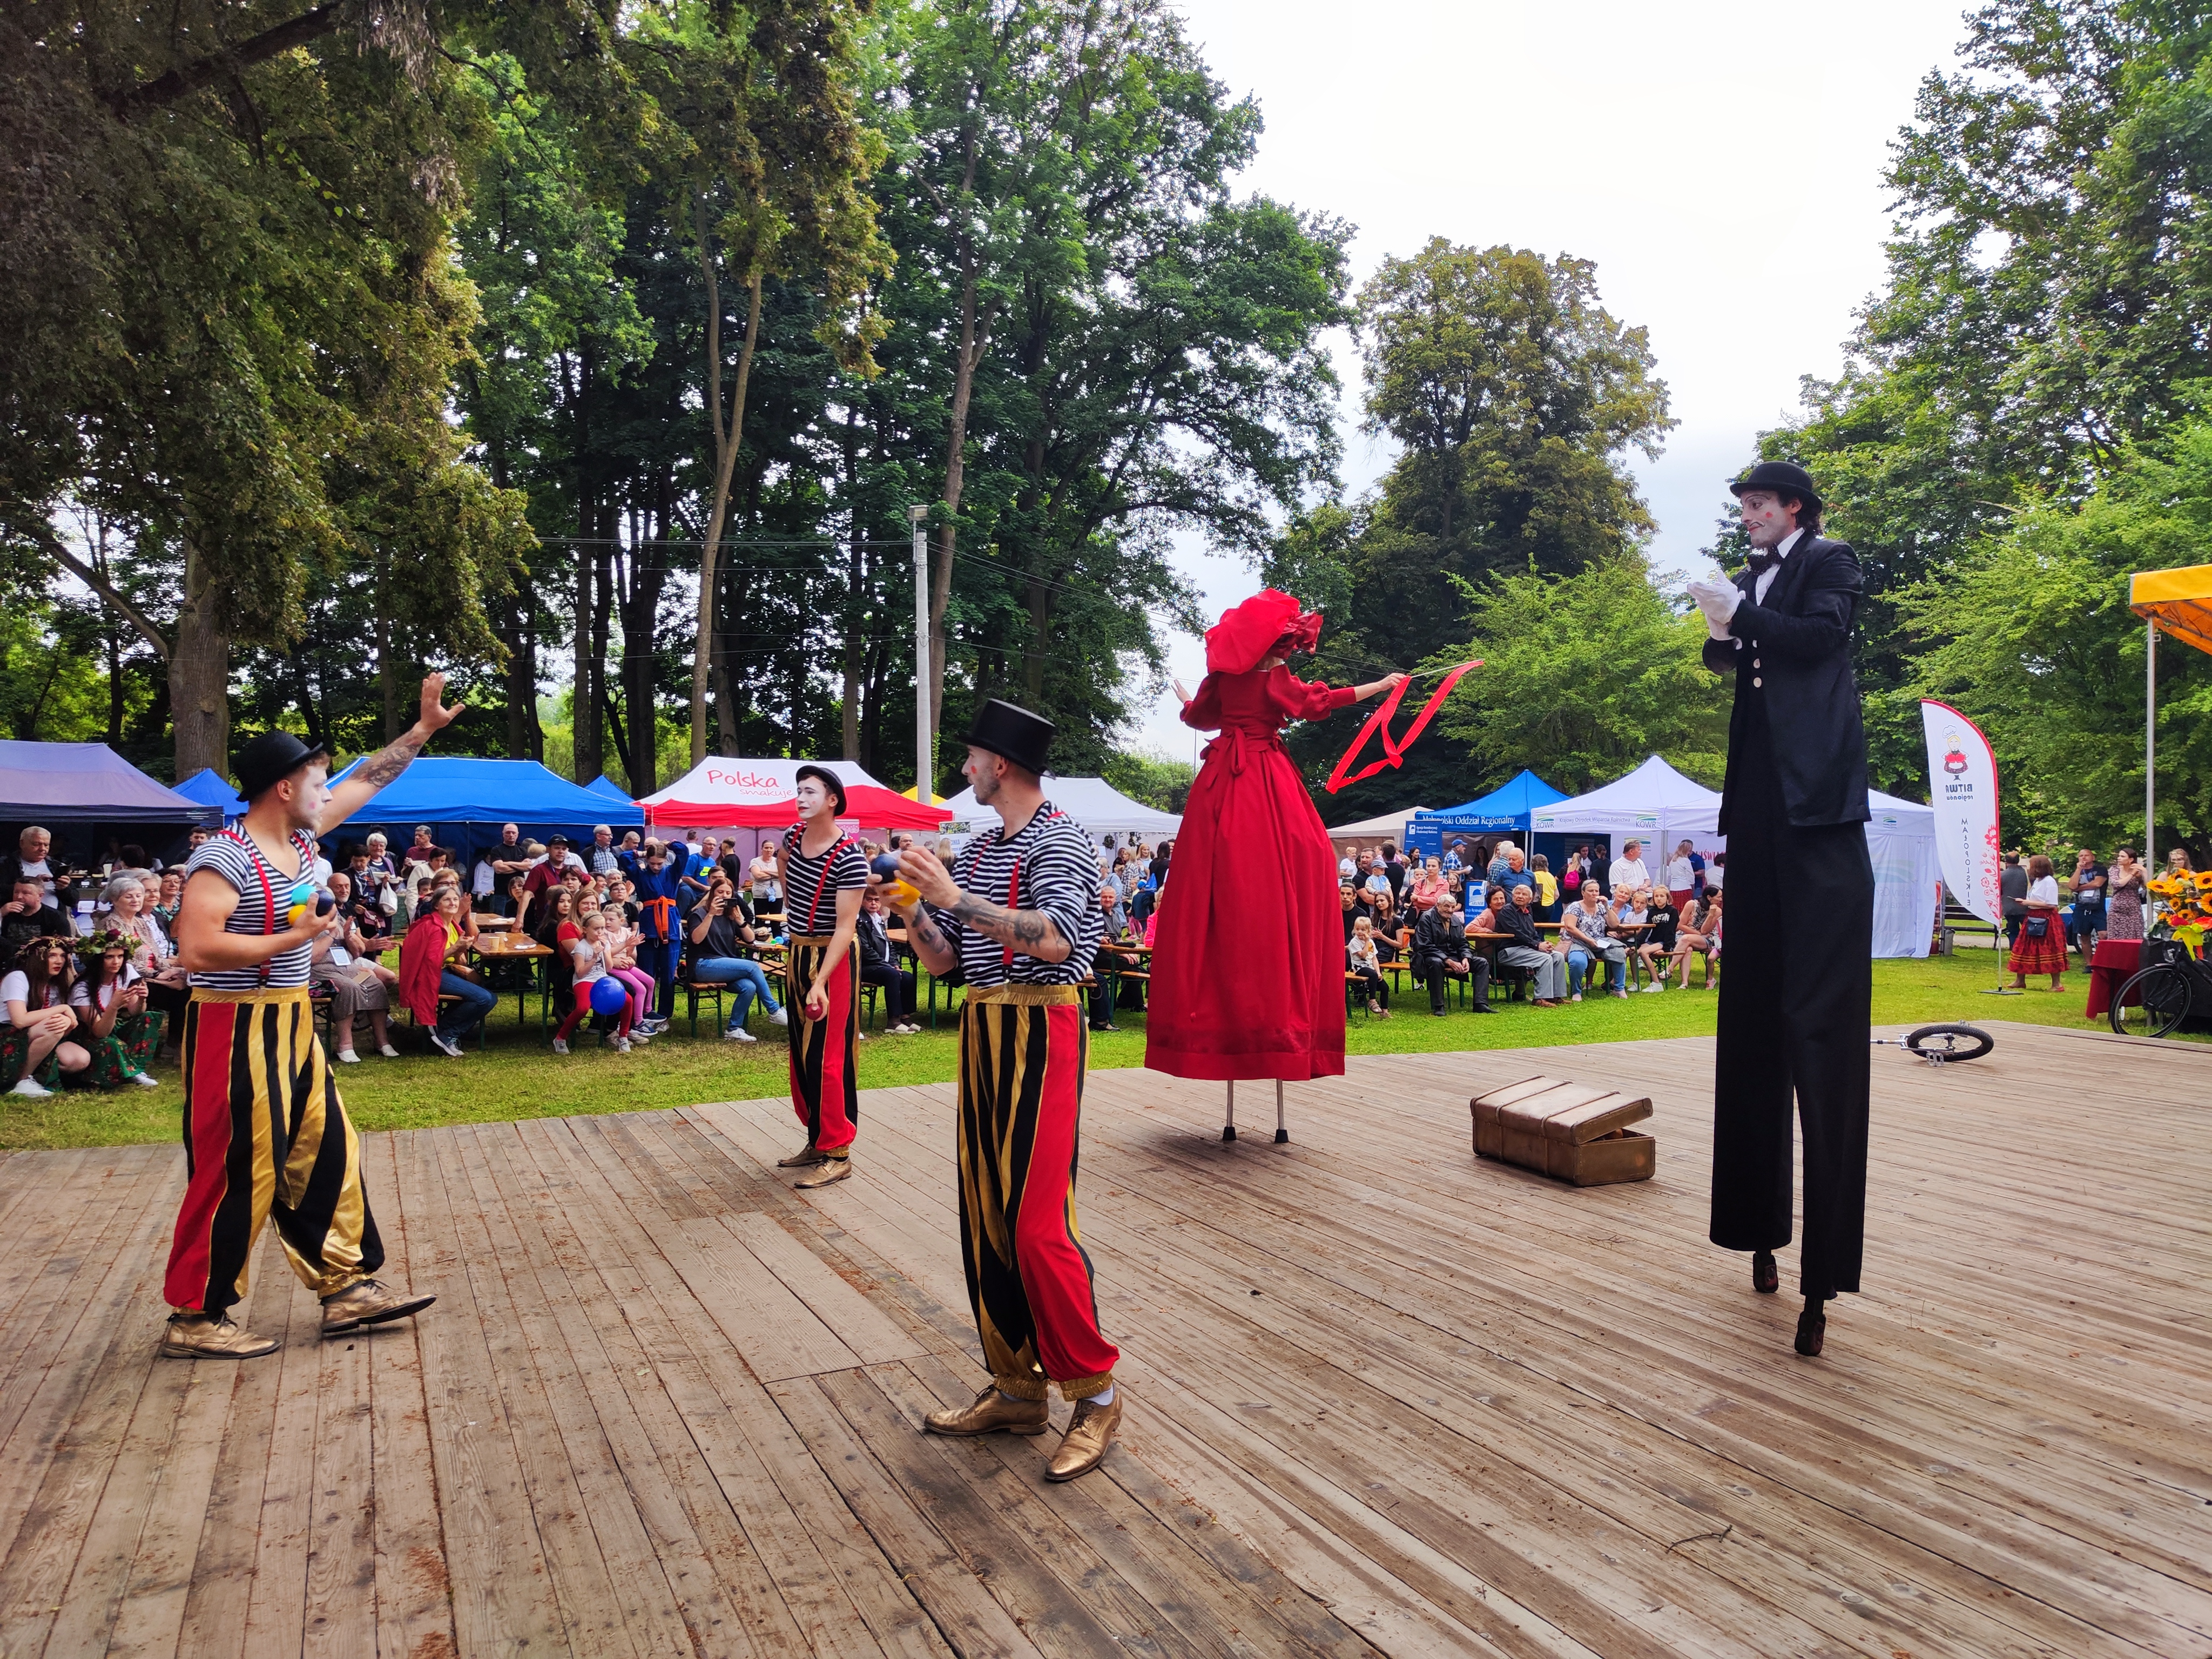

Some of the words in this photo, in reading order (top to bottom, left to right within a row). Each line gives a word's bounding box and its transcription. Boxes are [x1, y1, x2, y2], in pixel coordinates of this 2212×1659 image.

[706, 770, 780, 788] Polska
[740, 788, 793, 798] smakuje
[1455, 815, 1480, 825] Oddział
[1481, 814, 1515, 827] Regionalny
